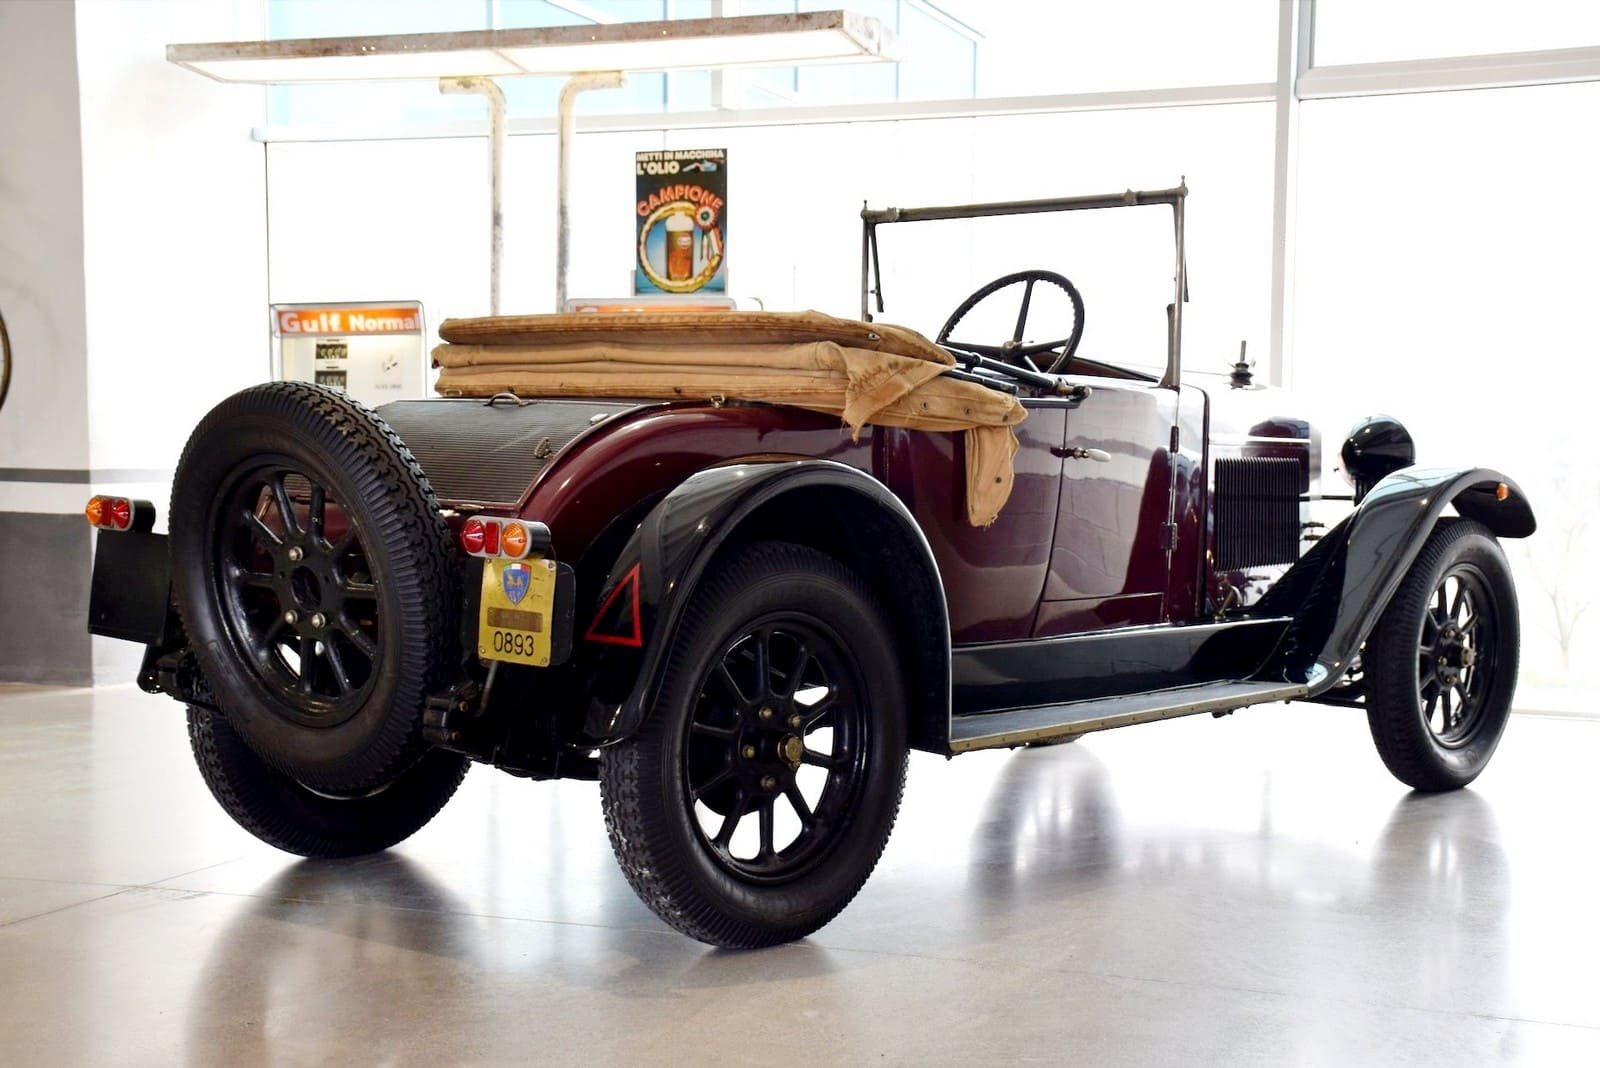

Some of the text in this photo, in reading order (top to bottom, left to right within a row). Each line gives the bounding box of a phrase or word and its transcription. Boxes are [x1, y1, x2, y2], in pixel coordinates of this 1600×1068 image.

[637, 150, 724, 162] METTI IN MACCHINA
[637, 161, 680, 175] L'OLIO
[637, 184, 723, 215] CAMPIONE
[280, 312, 421, 333] Gulf Normal
[494, 631, 534, 657] 0893
